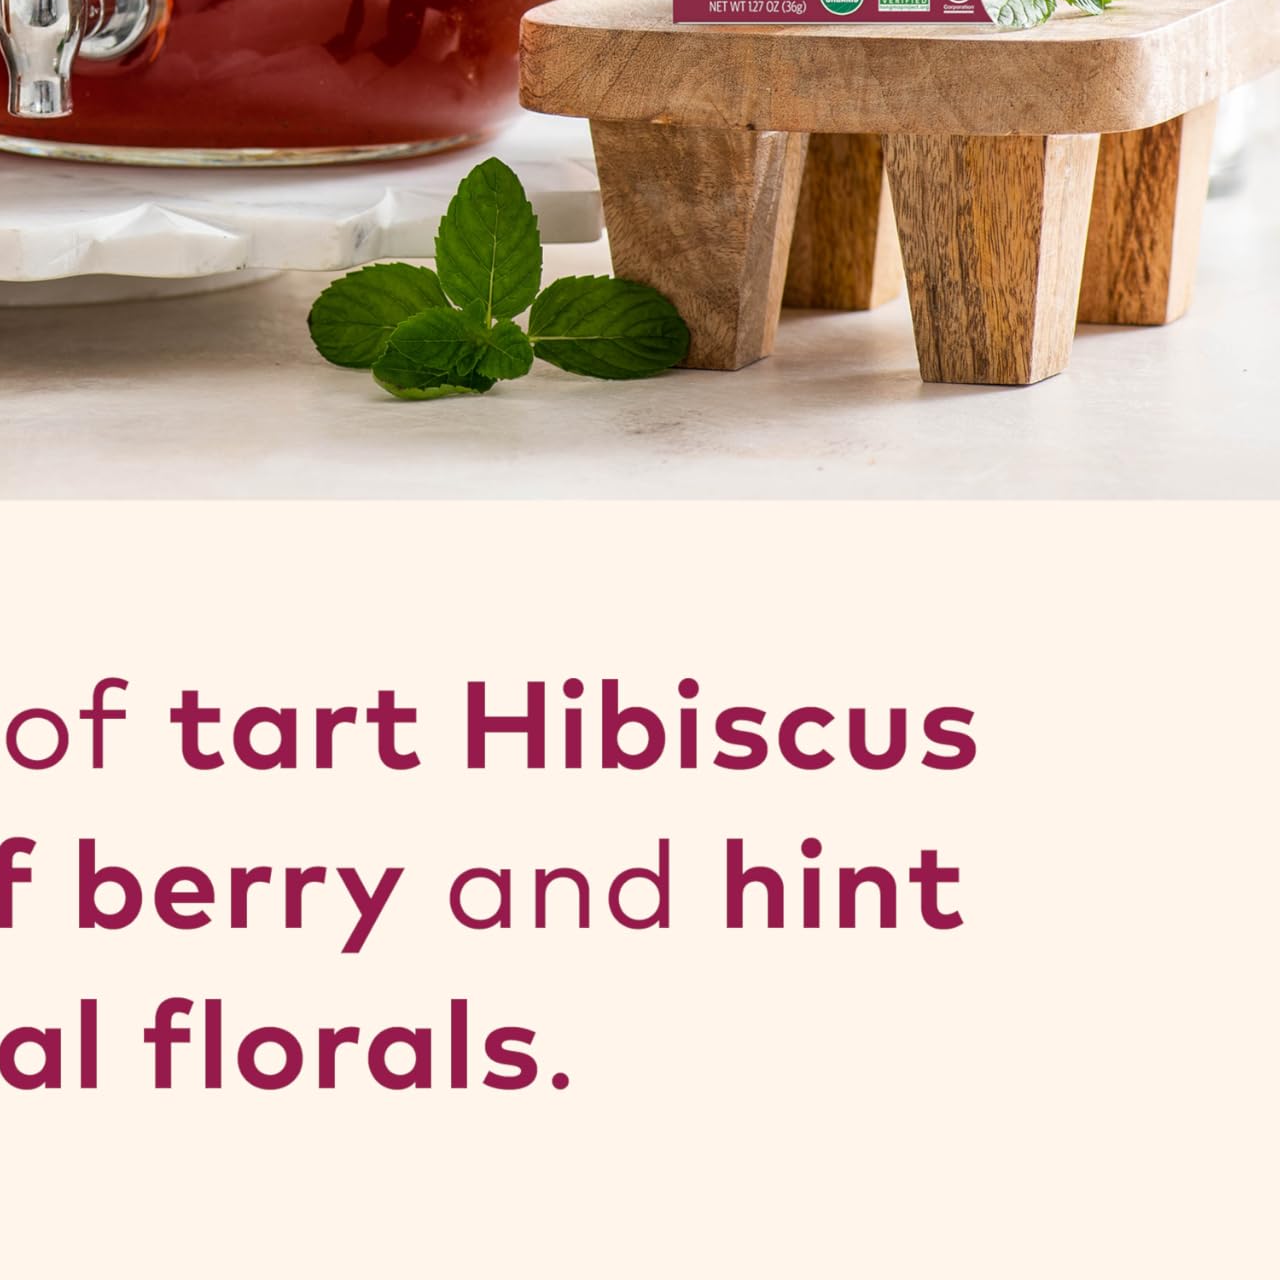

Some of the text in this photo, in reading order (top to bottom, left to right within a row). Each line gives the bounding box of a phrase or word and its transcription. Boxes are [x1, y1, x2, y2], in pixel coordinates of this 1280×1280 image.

[709, 1, 728, 12] NET
[730, 1, 746, 12] WT
[766, 1, 779, 12] OZ
[781, 1, 807, 14] (36g)
